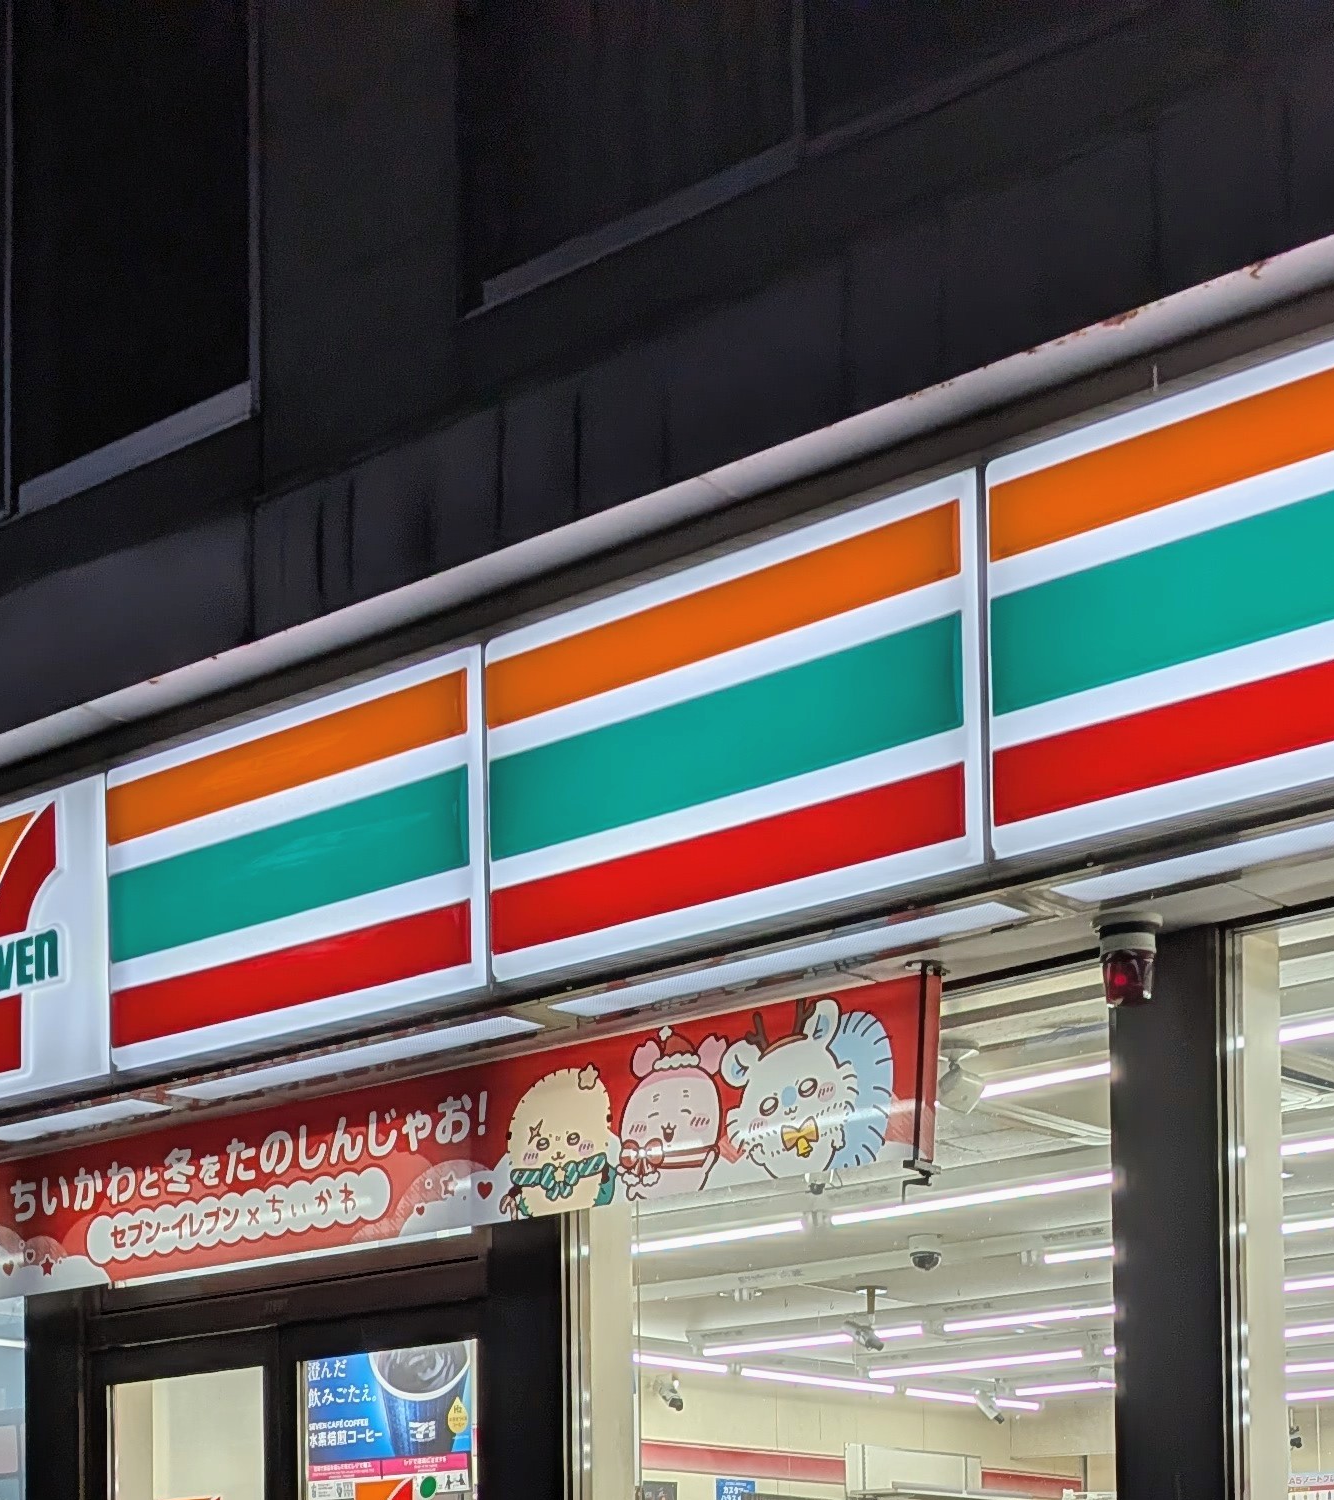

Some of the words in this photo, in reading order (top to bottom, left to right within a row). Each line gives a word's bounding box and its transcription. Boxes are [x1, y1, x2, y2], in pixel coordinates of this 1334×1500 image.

[10, 1091, 488, 1223] ちいかわと冬をたのしんじゃお!
[307, 1358, 346, 1381] 澄んだ
[344, 1417, 369, 1428] COFFEE
